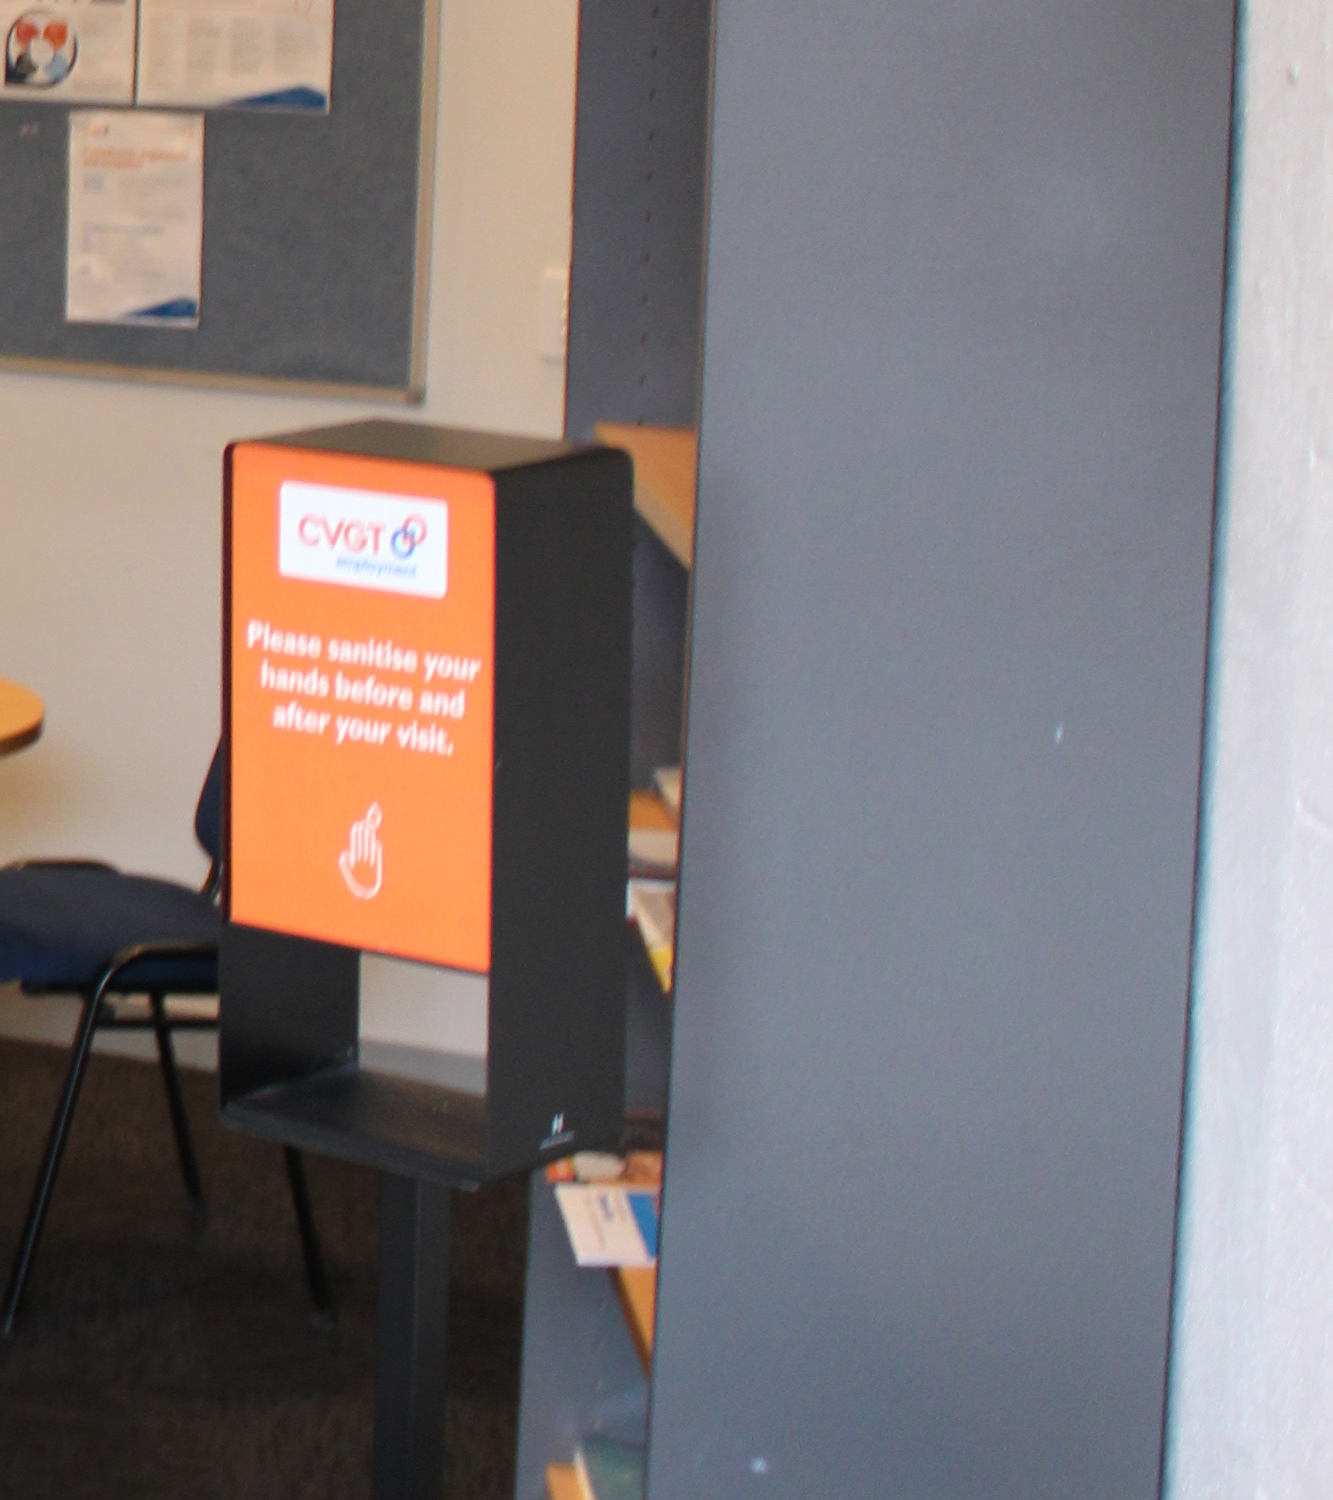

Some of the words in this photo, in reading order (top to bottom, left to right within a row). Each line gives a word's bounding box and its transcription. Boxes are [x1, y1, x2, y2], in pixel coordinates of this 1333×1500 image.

[298, 513, 385, 555] CVGT
[247, 619, 322, 659] Please
[328, 637, 418, 674] sanitise
[424, 651, 482, 683] your
[260, 658, 330, 699] hands
[336, 669, 414, 711] before
[419, 688, 466, 720] and
[272, 700, 331, 735] after
[336, 714, 392, 746] your
